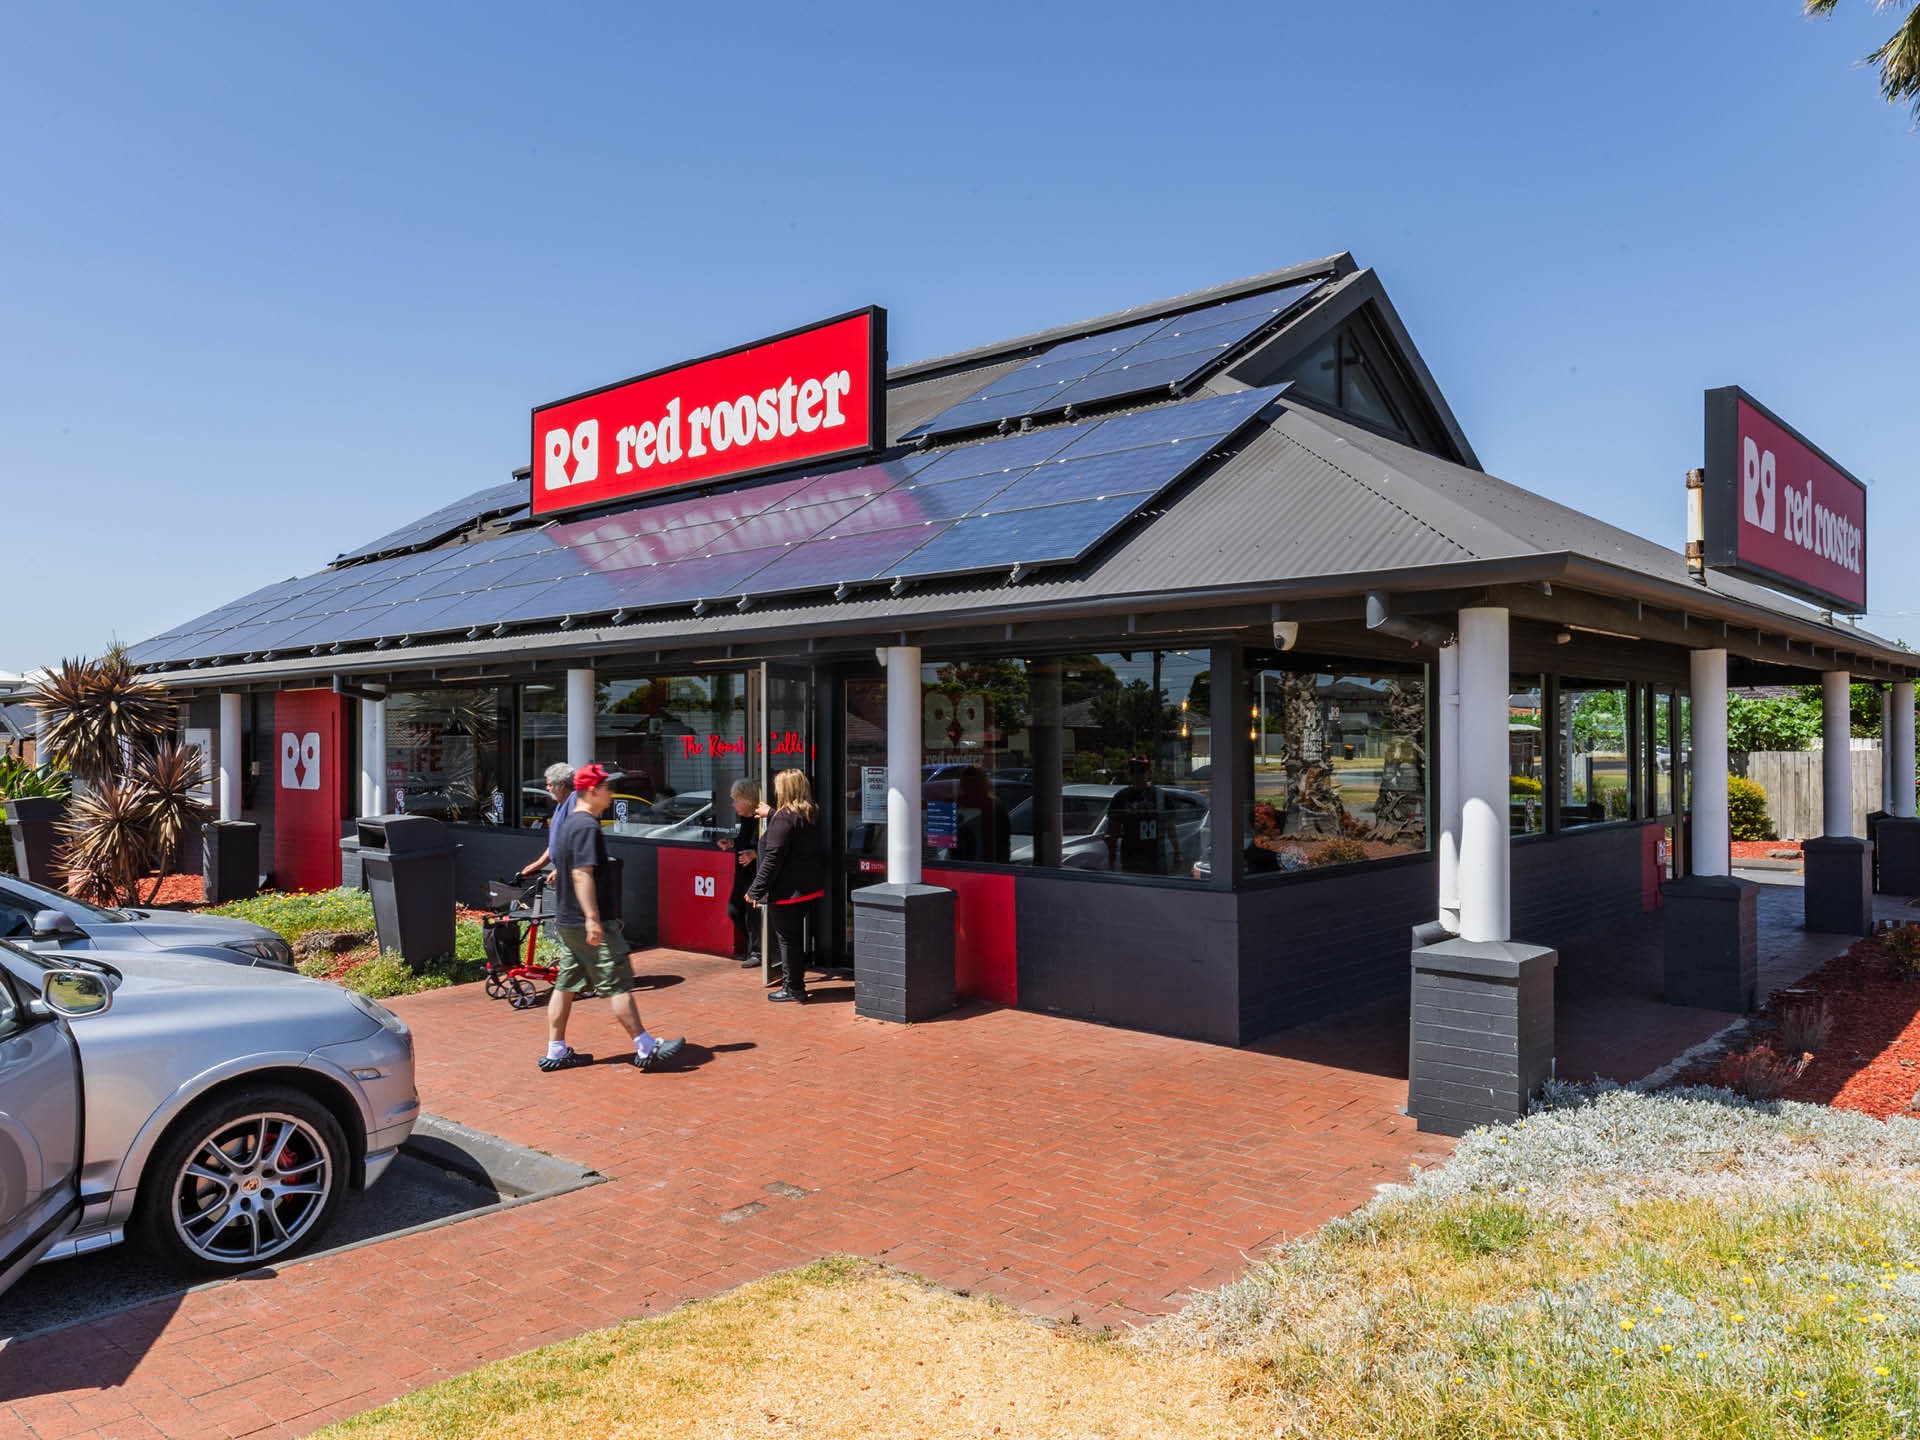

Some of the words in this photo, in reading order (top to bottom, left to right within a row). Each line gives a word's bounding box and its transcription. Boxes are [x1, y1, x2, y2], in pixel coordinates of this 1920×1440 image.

[616, 397, 683, 475] red
[688, 369, 851, 458] rooster
[1784, 479, 1813, 551] red
[1814, 502, 1862, 575] rooster
[679, 735, 704, 760] The
